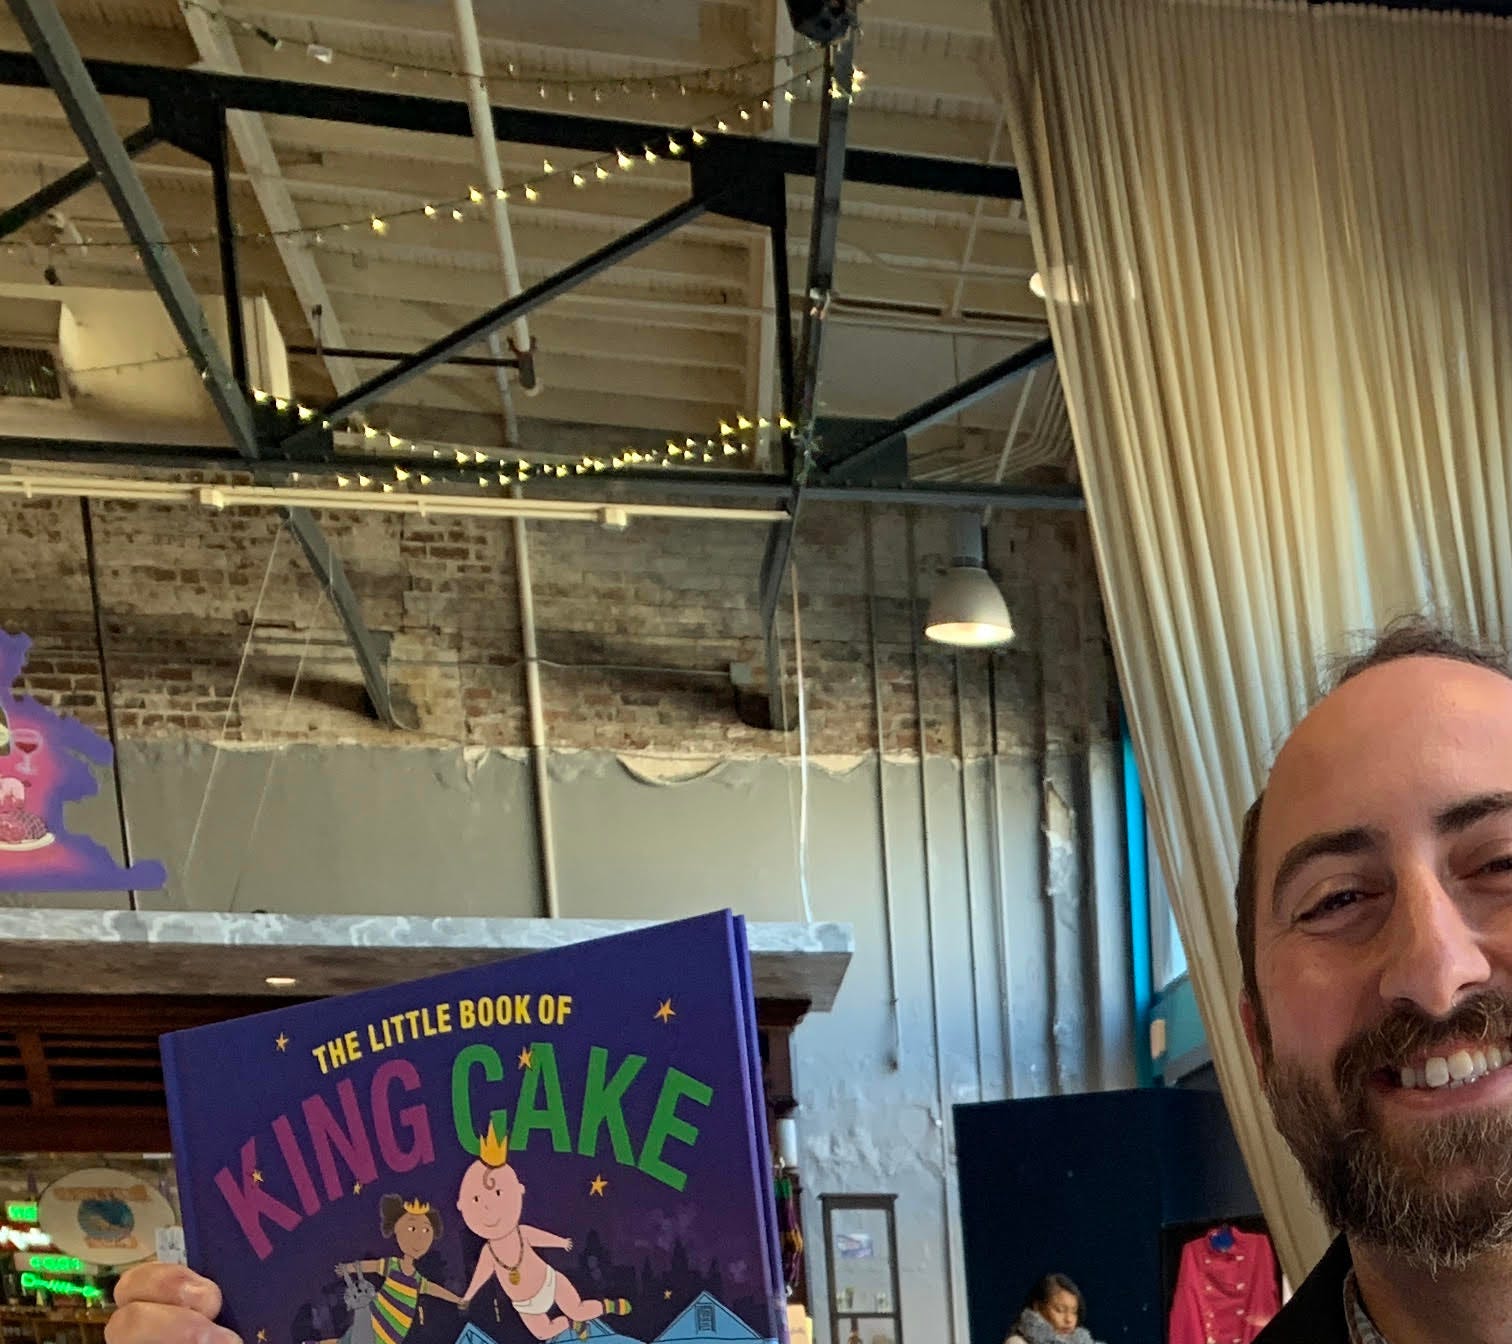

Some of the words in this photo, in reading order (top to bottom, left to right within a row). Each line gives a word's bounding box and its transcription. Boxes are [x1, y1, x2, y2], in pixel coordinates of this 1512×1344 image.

[312, 1031, 362, 1074] THE
[368, 1003, 451, 1052] LITTLE
[459, 994, 532, 1029] BOOK
[538, 994, 572, 1025] OF
[214, 1059, 435, 1261] KING
[452, 1042, 714, 1192] CAKE
